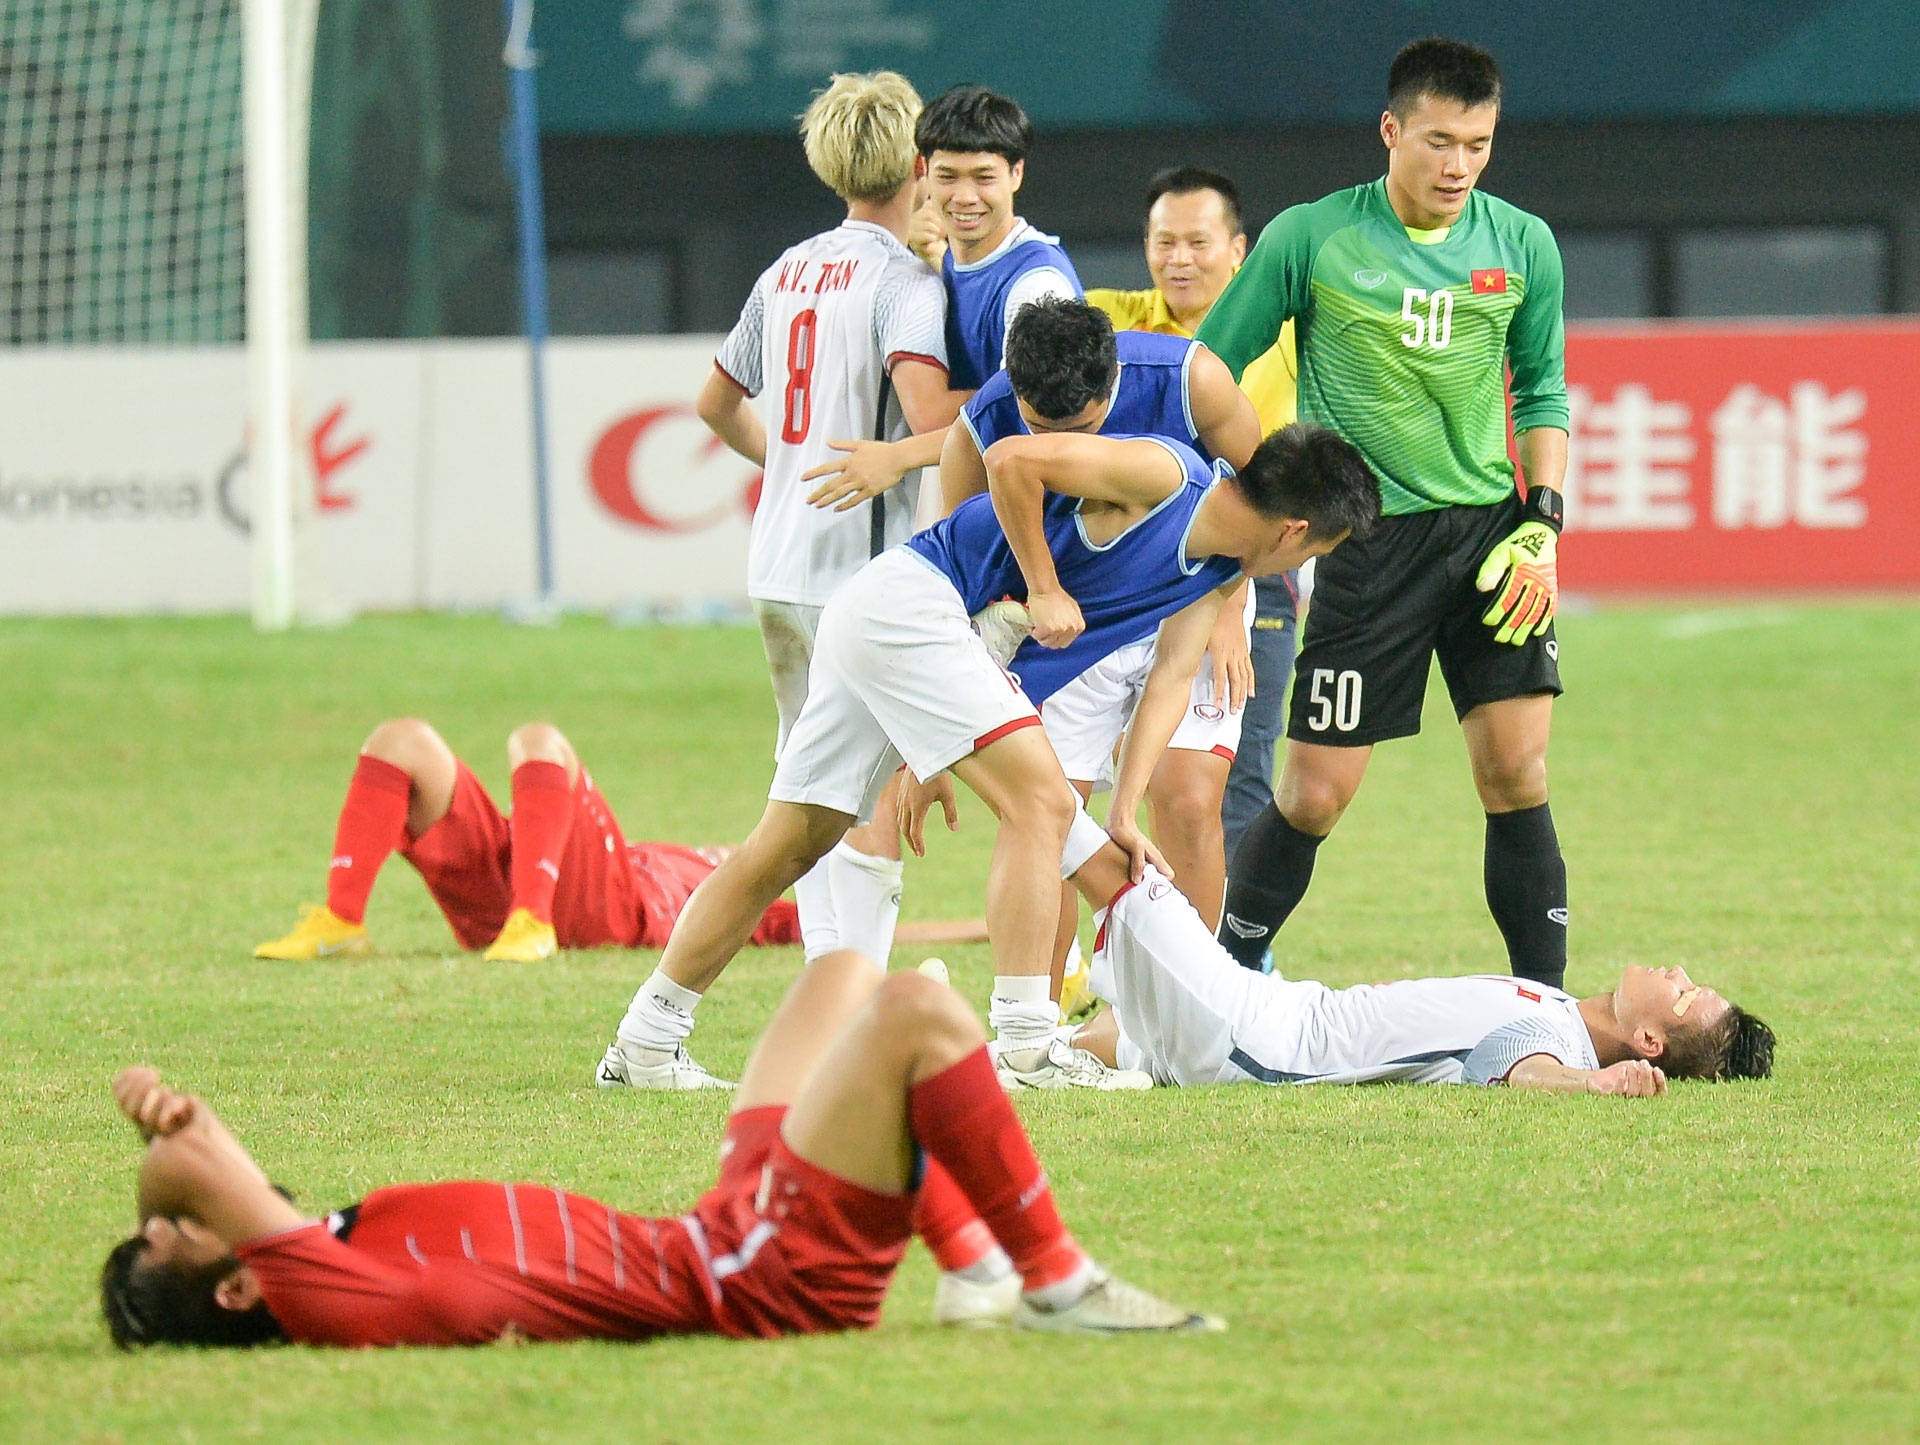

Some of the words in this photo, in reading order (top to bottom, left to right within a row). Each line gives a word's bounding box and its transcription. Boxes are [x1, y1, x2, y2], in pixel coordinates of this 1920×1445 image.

[1400, 287, 1454, 349] 50
[781, 308, 817, 444] 8
[1562, 379, 1869, 531] 佳能
[0, 471, 203, 521] onesia
[1308, 668, 1362, 731] 50
